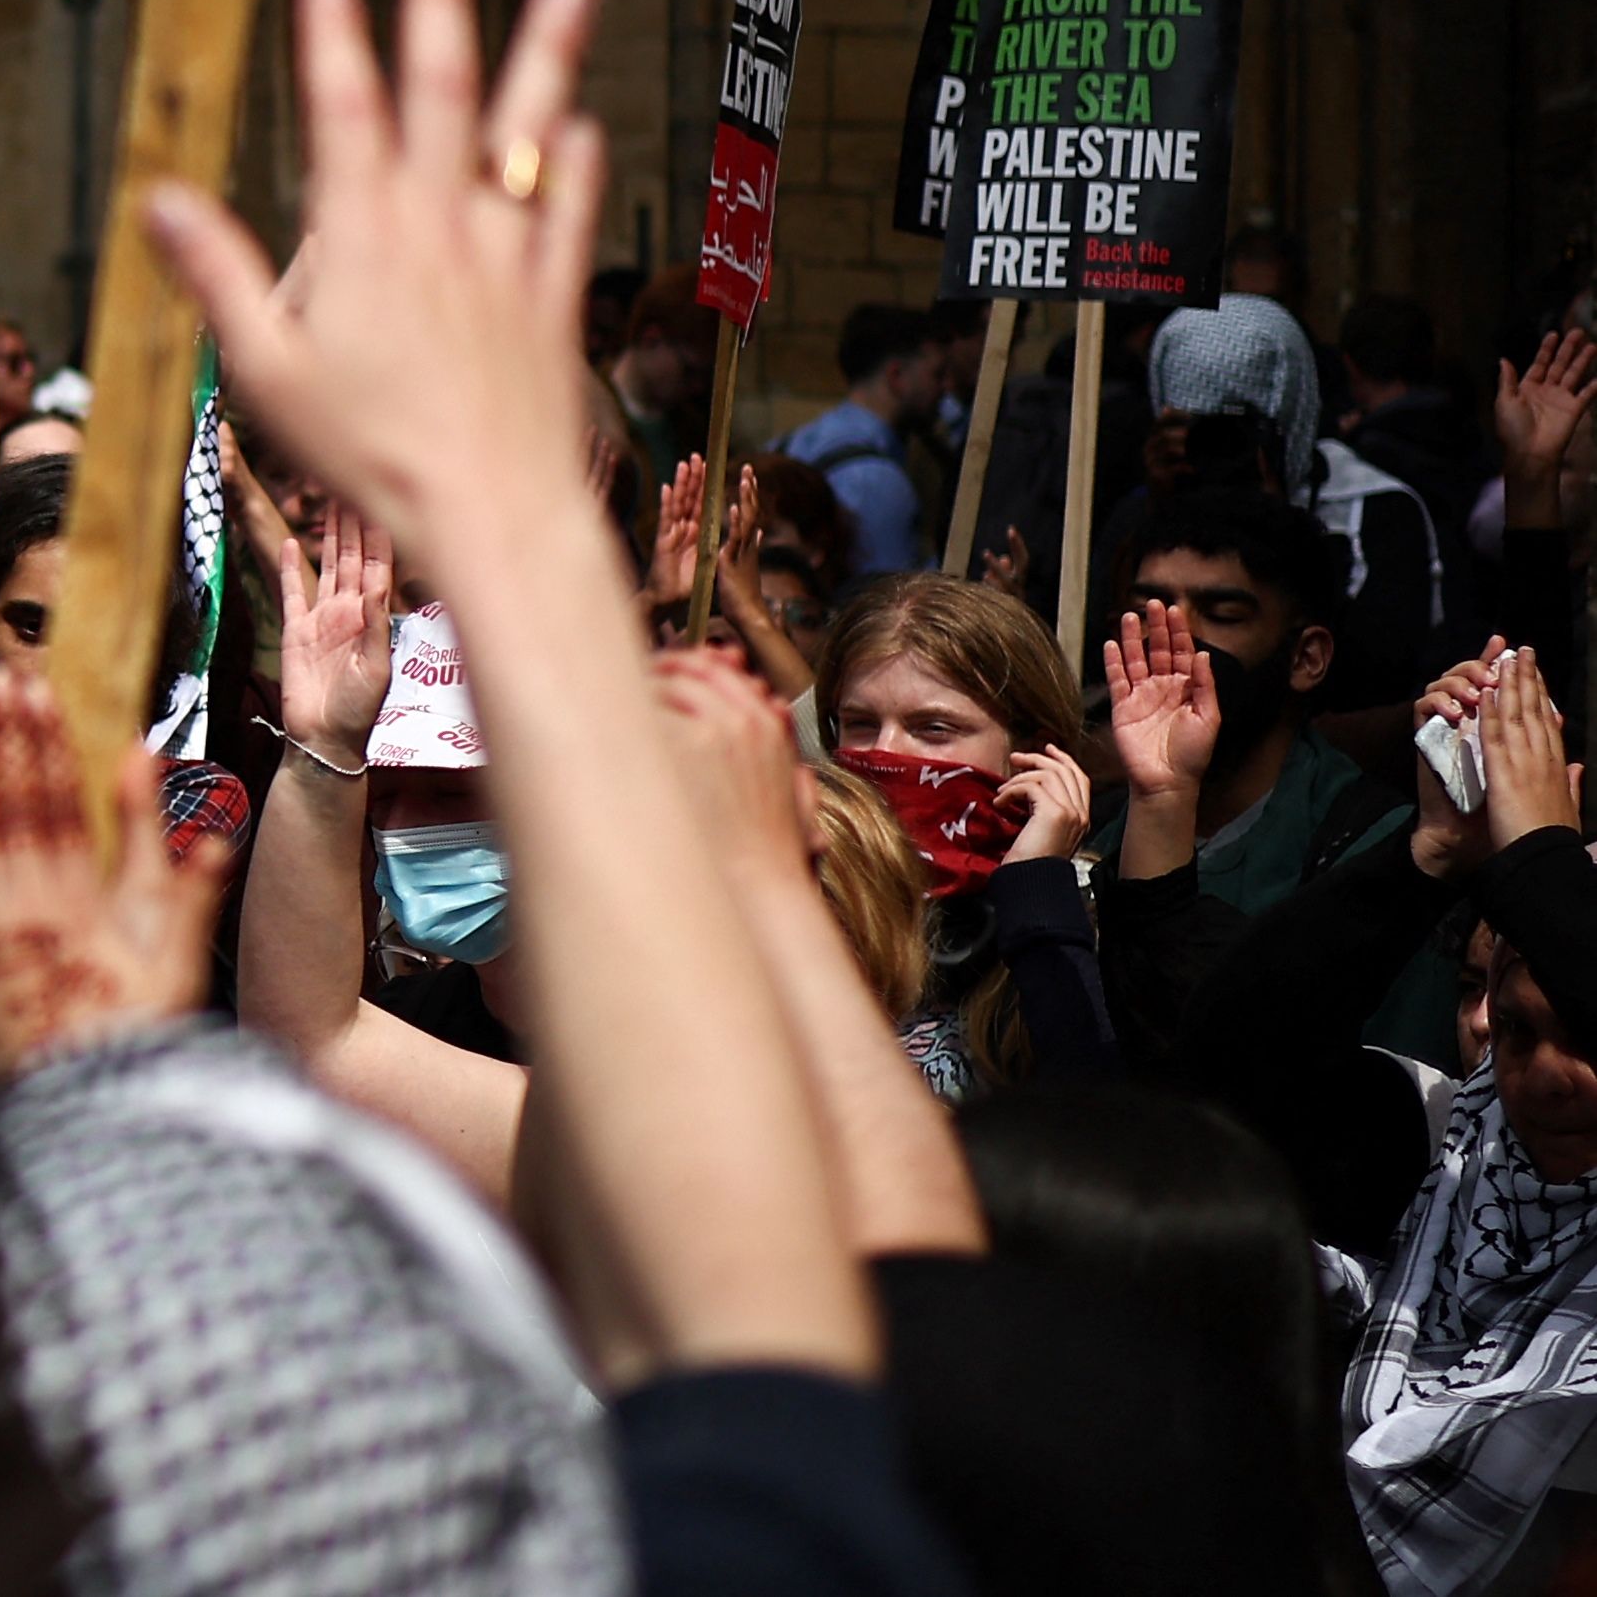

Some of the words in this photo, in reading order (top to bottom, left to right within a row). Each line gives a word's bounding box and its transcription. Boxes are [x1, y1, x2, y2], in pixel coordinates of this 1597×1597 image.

[995, 19, 1108, 72] RIVER
[1124, 19, 1176, 71] TO
[992, 74, 1062, 126] THE
[1075, 75, 1151, 124] SEA
[981, 127, 1200, 182] PALESTINE
[977, 183, 1070, 234] WILL
[1084, 183, 1140, 235] BE
[968, 236, 1070, 288] FREE
[1085, 240, 1133, 262] Back
[1138, 242, 1170, 265] the
[1082, 266, 1185, 294] resistance
[374, 742, 420, 761] TORIES
